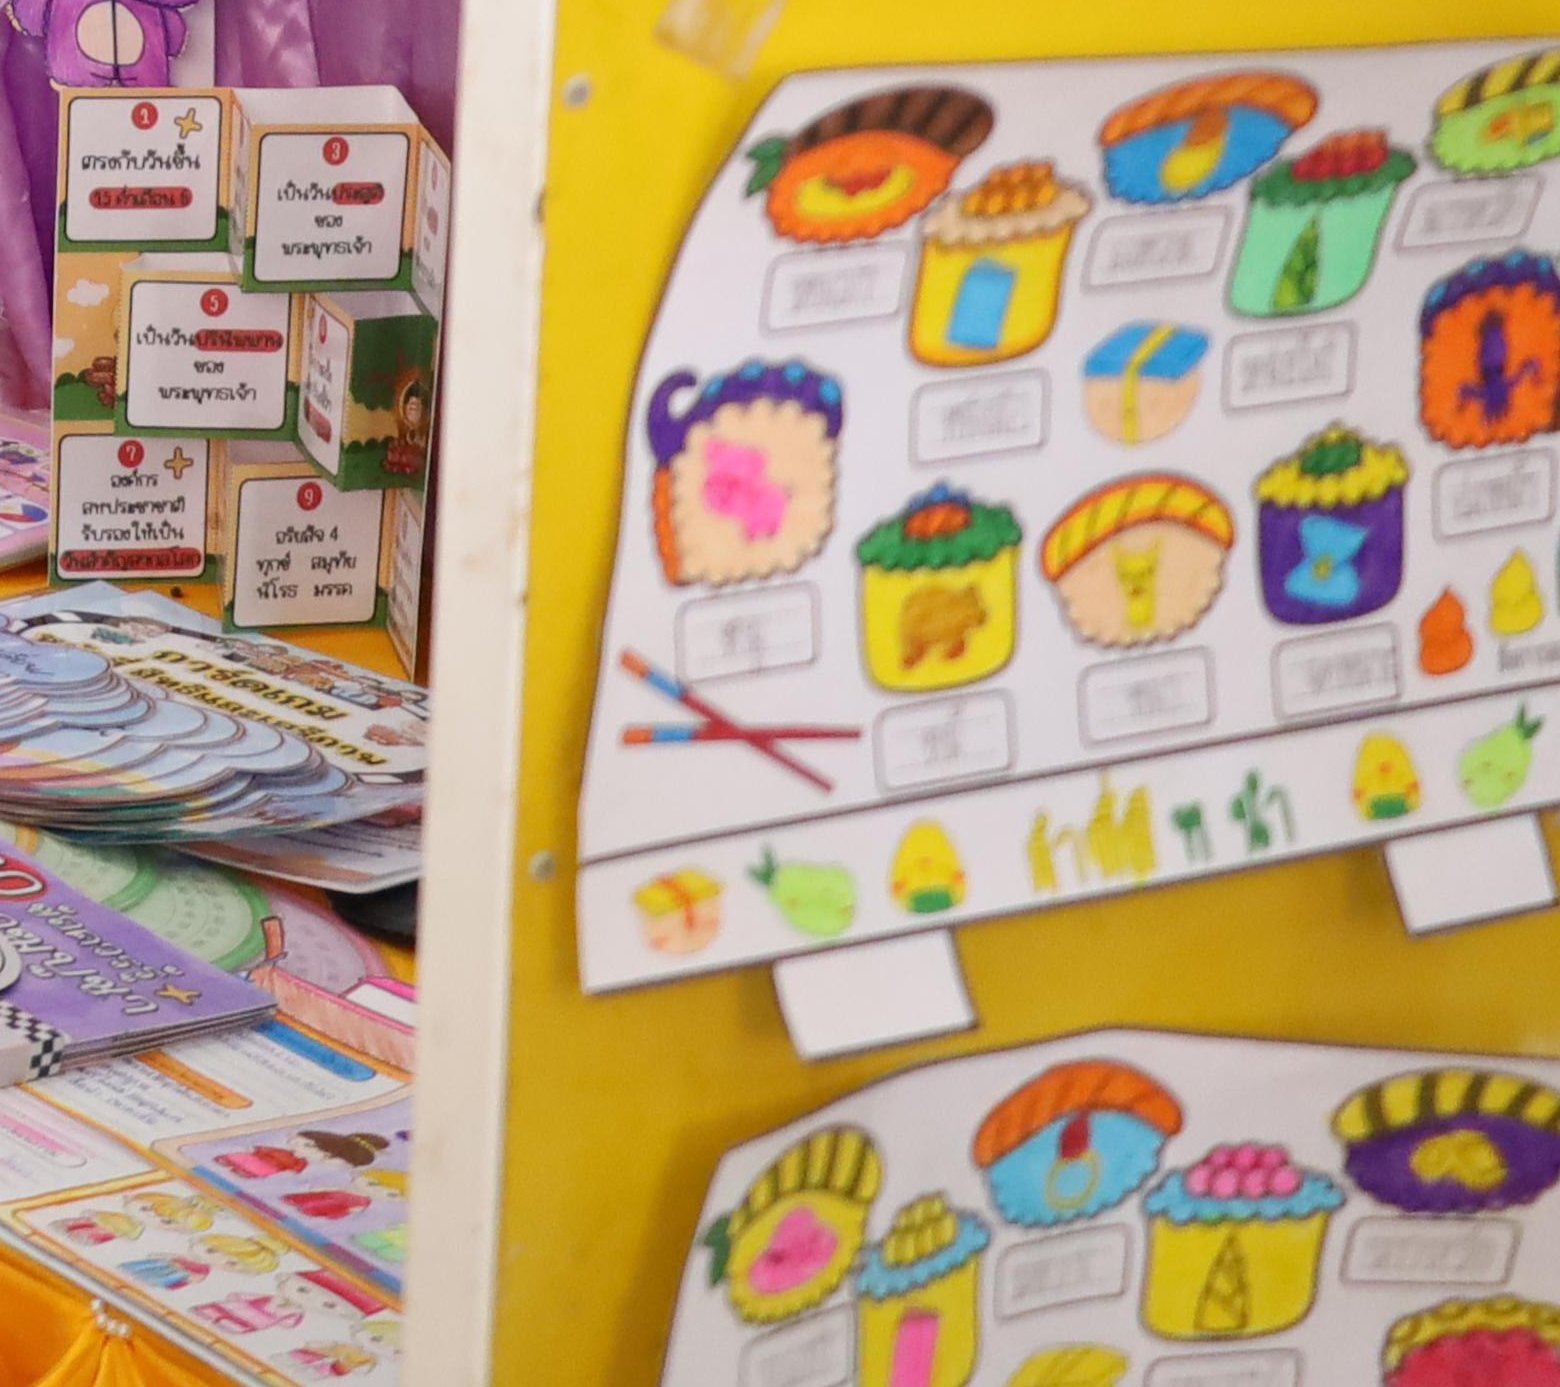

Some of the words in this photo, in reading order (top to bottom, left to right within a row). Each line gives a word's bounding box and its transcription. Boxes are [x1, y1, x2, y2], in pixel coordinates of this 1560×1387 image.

[81, 142, 201, 174] ตรงกับวันขึ้น
[313, 212, 344, 229] ของ
[281, 236, 373, 261] พระพุทธเจ้า
[193, 358, 225, 375] ของ
[158, 381, 257, 407] พระพุทธเจ้า
[329, 525, 340, 543] 4
